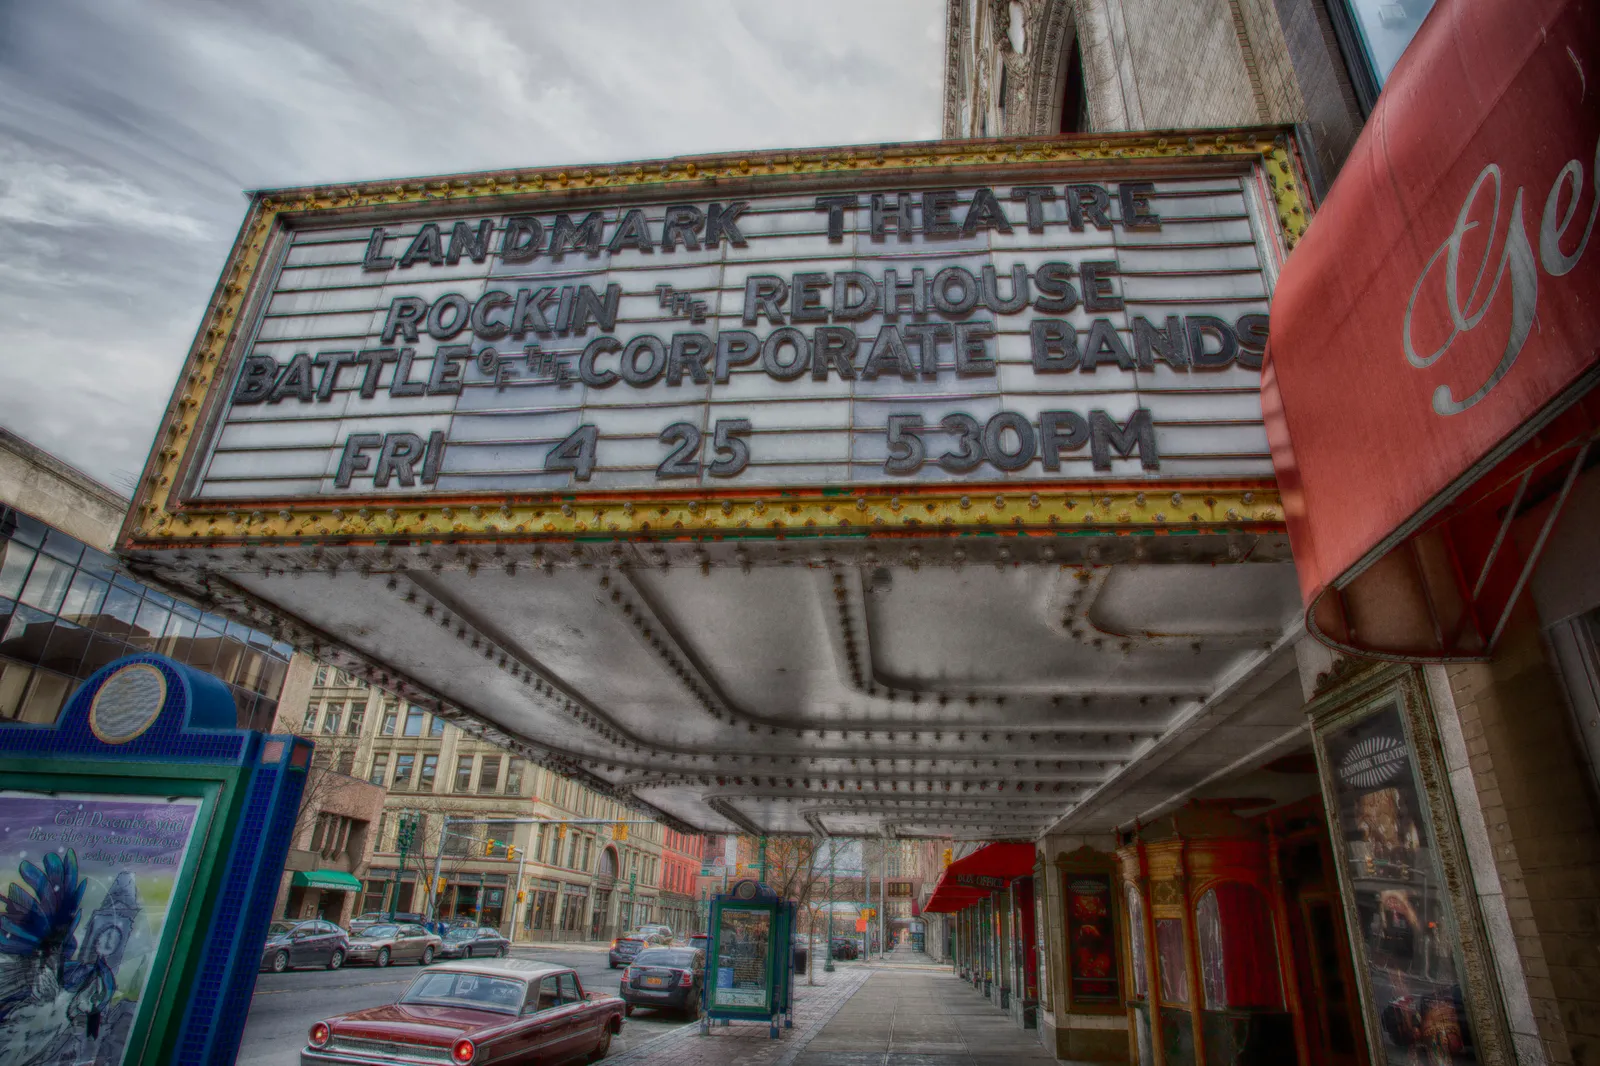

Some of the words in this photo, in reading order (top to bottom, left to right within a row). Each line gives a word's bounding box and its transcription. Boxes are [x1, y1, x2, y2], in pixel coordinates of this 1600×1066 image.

[363, 202, 749, 271] LANDMARK
[816, 182, 1161, 241] THEATRE
[381, 283, 619, 342] ROCKIN
[655, 284, 708, 324] THE
[742, 260, 1125, 326] REDHOUSE
[1403, 135, 1600, 416] Ge
[232, 344, 472, 401] BATTLE
[477, 347, 516, 391] OF
[523, 344, 572, 390] THE
[579, 320, 996, 386] CORPORATE
[1030, 313, 1270, 374] BANDS
[334, 430, 445, 488] FRI
[543, 422, 599, 481] 4
[655, 418, 753, 482] 25
[1340, 757, 1373, 778] LANDMARK
[1372, 745, 1408, 764] THEATRE
[54, 809, 88, 827] Cold
[88, 812, 150, 831] December
[59, 828, 82, 843] blue
[83, 831, 101, 848] jay
[82, 850, 115, 867] seeking
[118, 850, 132, 864] his
[134, 851, 151, 865] last
